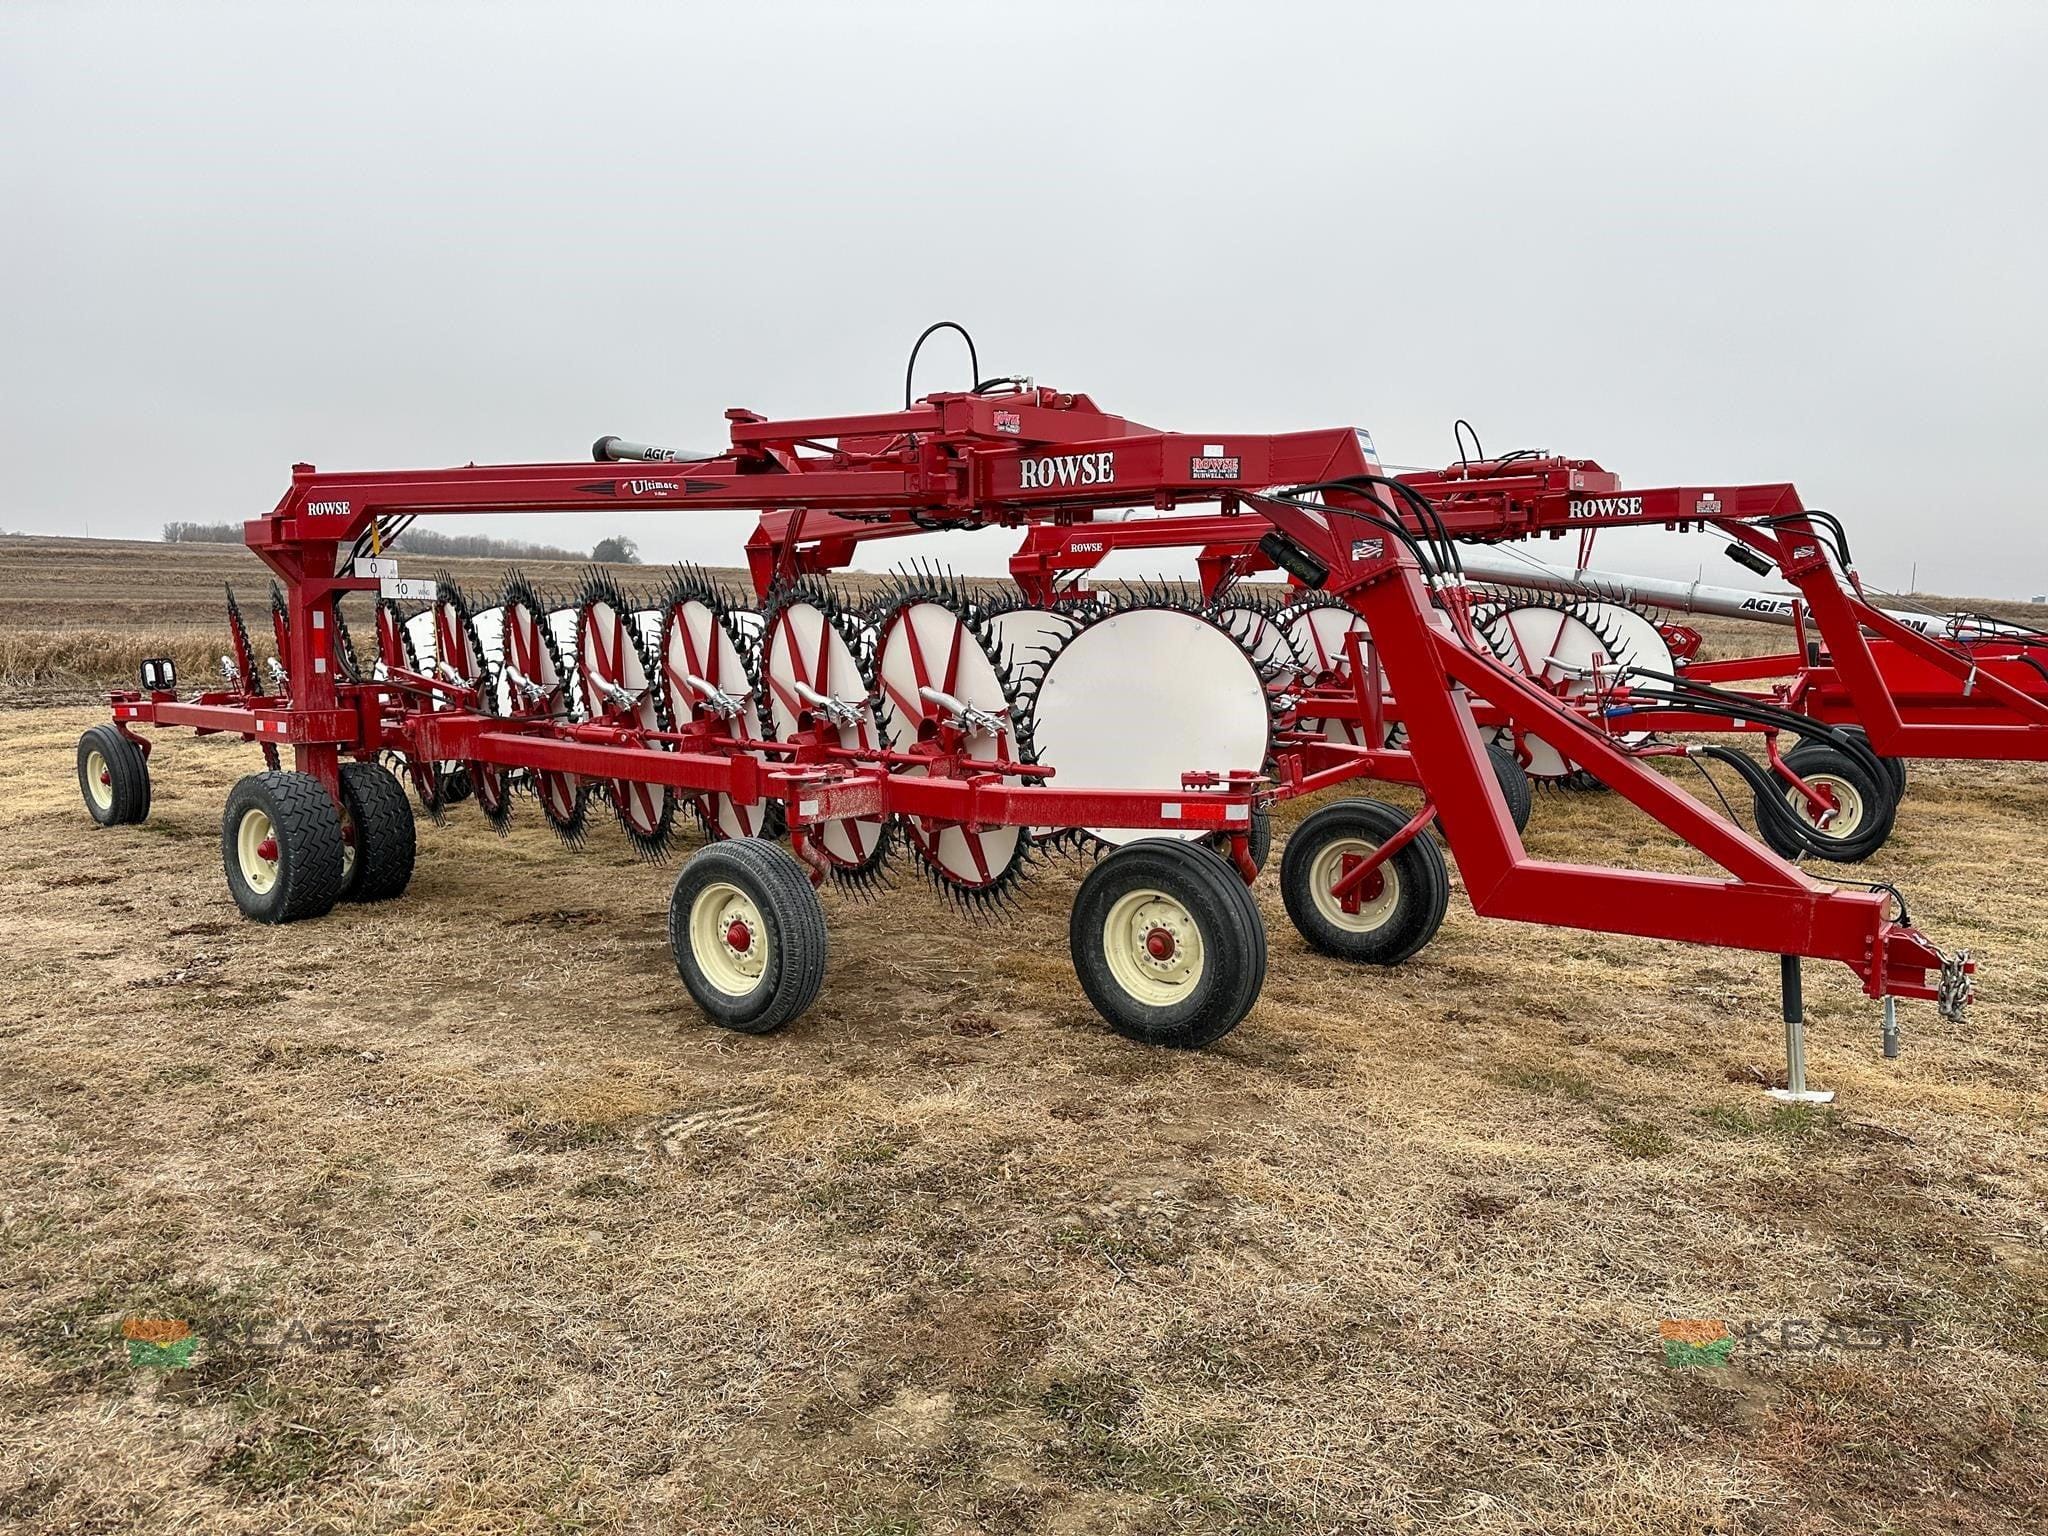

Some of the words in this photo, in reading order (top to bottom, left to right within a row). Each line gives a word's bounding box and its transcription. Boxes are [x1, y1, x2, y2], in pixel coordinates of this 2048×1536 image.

[644, 447, 666, 460] AGI
[1020, 452, 1115, 488] ROWSE
[1192, 457, 1239, 470] ROWSE
[631, 480, 679, 494] Ultimate
[307, 502, 351, 515] ROWSE
[1568, 497, 1643, 519] ROWSE
[1071, 543, 1103, 552] ROWSE
[370, 562, 377, 573] 0
[395, 583, 408, 595] 10
[1740, 597, 1778, 613] AGI
